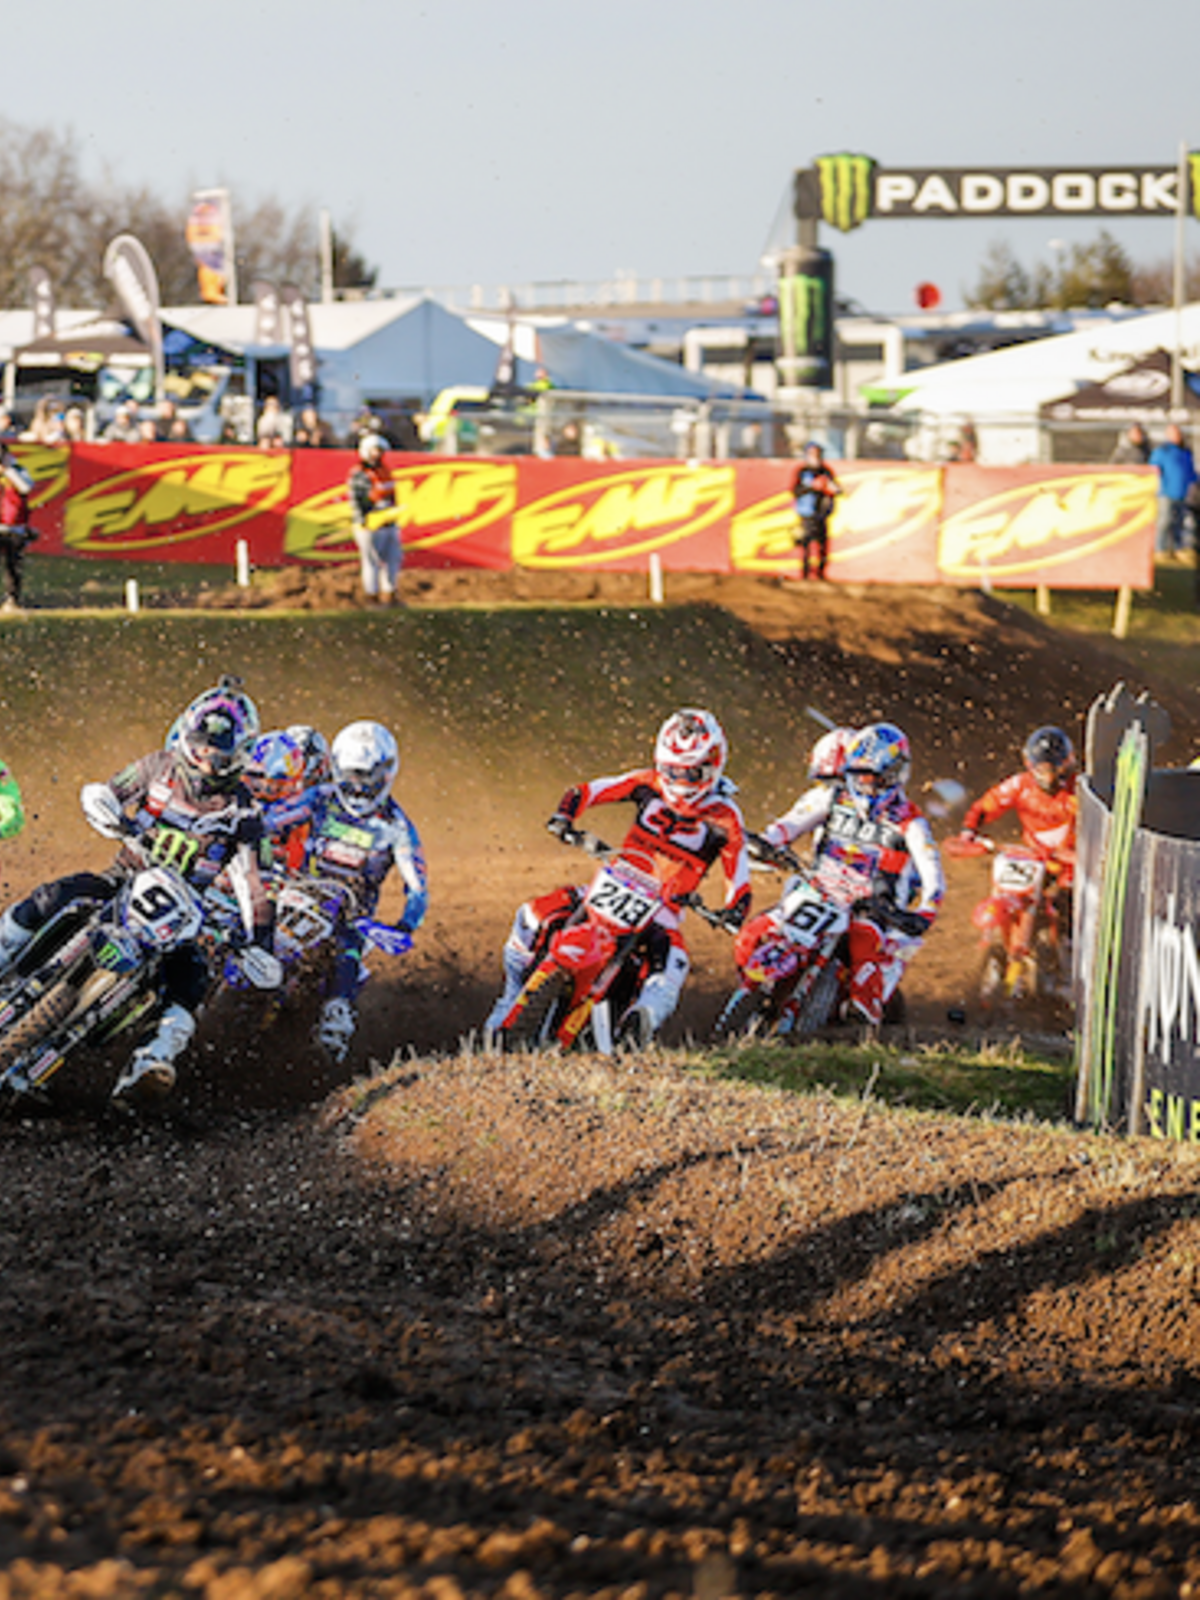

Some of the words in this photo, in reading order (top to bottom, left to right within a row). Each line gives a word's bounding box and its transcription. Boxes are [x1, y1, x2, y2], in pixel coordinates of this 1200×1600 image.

[875, 173, 1181, 212] PADDOCK
[65, 454, 291, 548] FMF
[512, 467, 735, 565] FMF
[939, 473, 1158, 573] FMF
[589, 882, 651, 927] 243
[788, 901, 839, 936] 61
